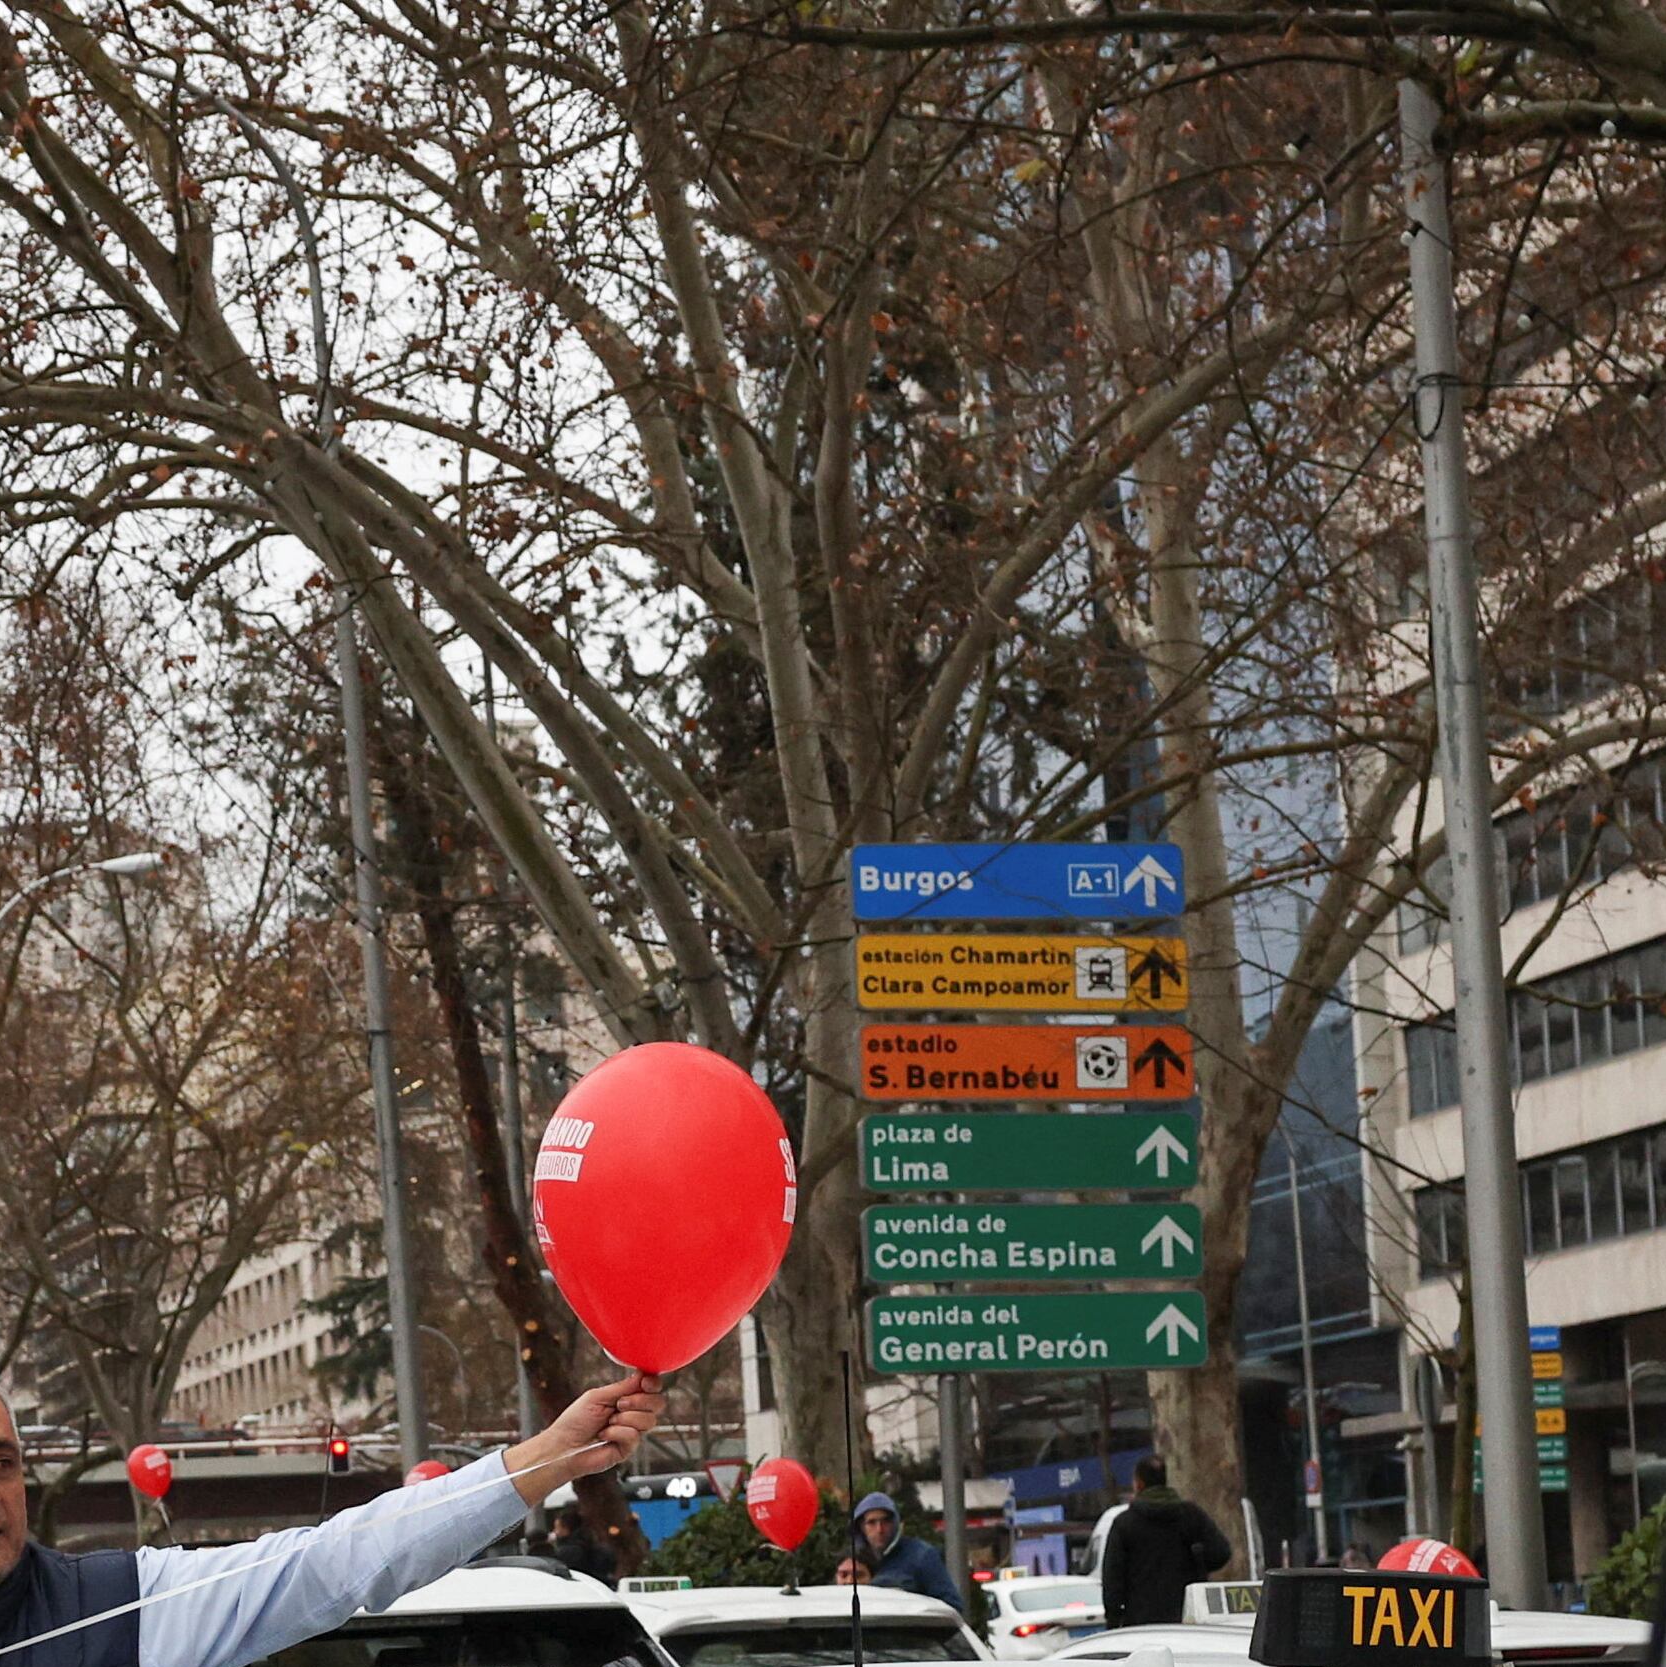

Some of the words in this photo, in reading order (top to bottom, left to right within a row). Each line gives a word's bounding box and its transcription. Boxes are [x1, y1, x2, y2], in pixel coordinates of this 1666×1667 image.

[859, 865, 975, 897] Burgos
[1075, 870, 1116, 892] A-1
[862, 946, 944, 965] estación
[863, 975, 925, 994] Clara
[931, 976, 1071, 998] Campoamor
[866, 1035, 958, 1055] estadio
[868, 1067, 899, 1089] S.
[906, 1065, 1060, 1090] Bernabéu
[871, 1124, 936, 1146] plaza
[943, 1124, 973, 1144] de
[872, 1157, 950, 1183] Lima
[874, 1214, 970, 1235] avenida
[977, 1214, 1007, 1234] de
[874, 1243, 998, 1269] Concha
[1008, 1242, 1117, 1272] Espina
[878, 1305, 974, 1326] avenida
[981, 1304, 1020, 1325] del
[879, 1336, 1006, 1363] General
[1015, 1332, 1109, 1361] Perón
[666, 1477, 697, 1498] 40
[1343, 1586, 1454, 1649] TAXI
